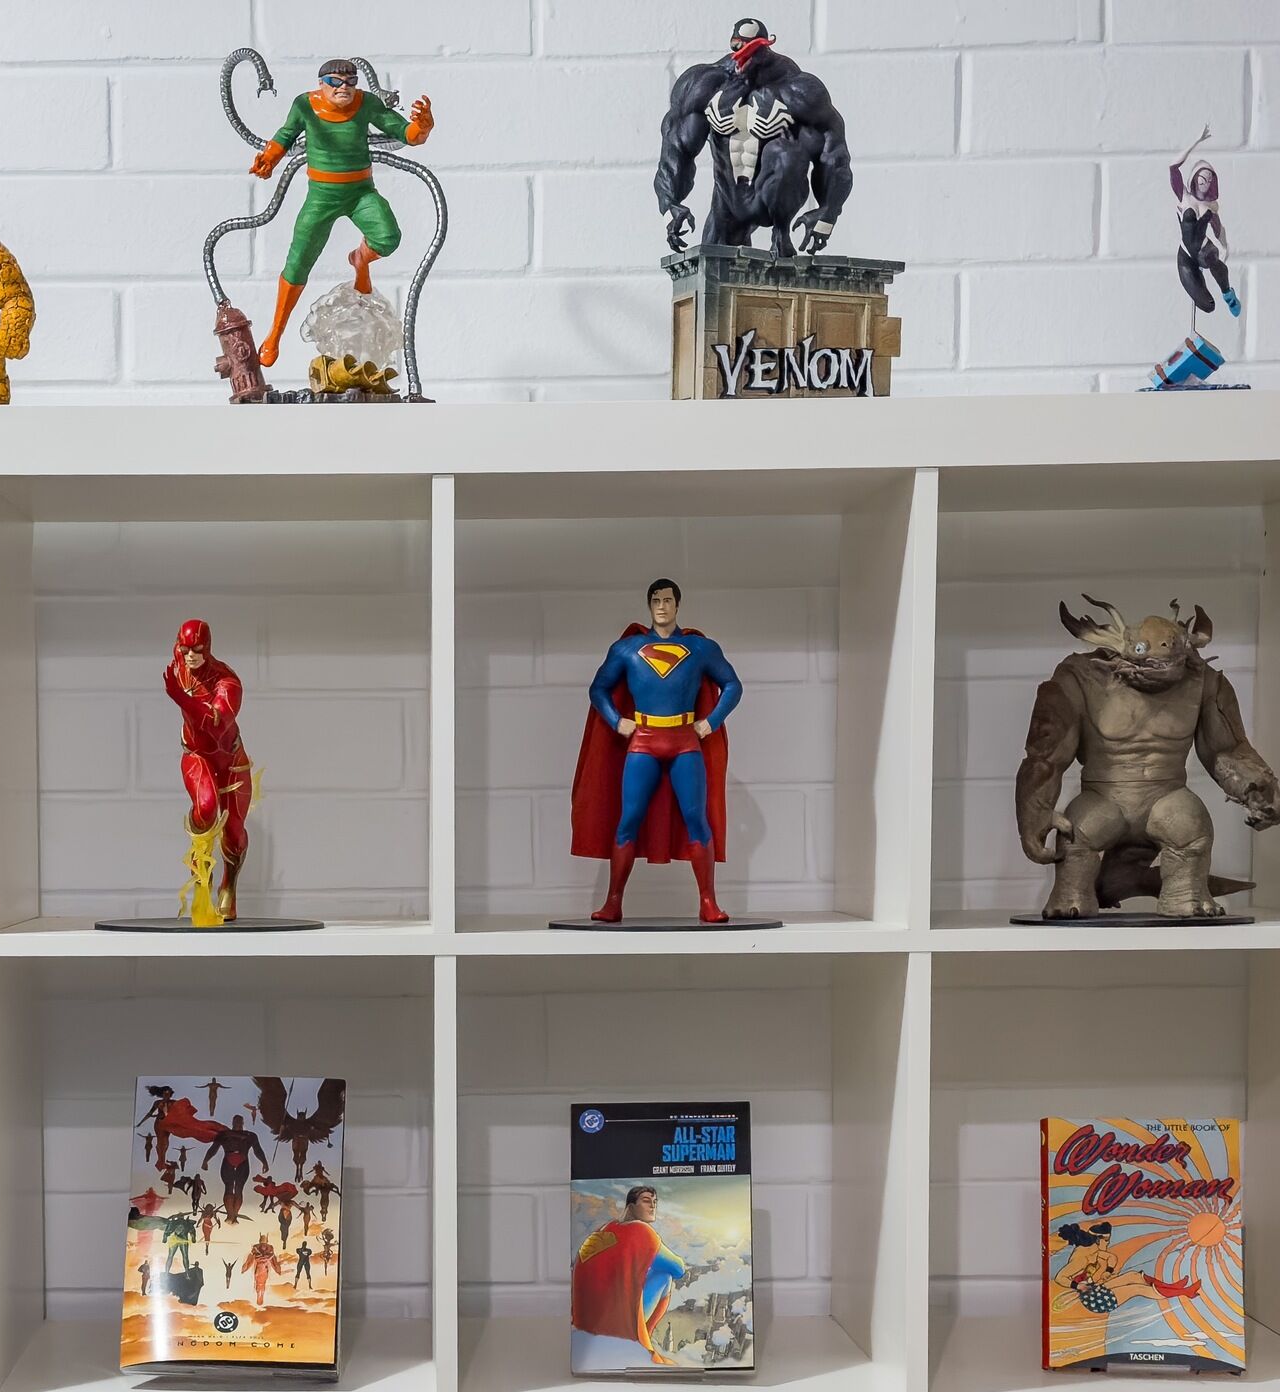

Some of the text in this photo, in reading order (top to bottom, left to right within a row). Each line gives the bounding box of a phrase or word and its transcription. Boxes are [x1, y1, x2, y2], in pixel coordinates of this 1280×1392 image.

[711, 328, 875, 397] VENOM
[673, 1126, 735, 1144] ALL-STAR
[1146, 1124, 1231, 1132] THE LITTLE BOOK OF
[662, 1143, 735, 1162] SUPERMAN
[1053, 1124, 1191, 1176] Wonder
[1081, 1163, 1235, 1215] Woman
[251, 1341, 296, 1349] COME
[1129, 1353, 1165, 1361] TASCHEN
